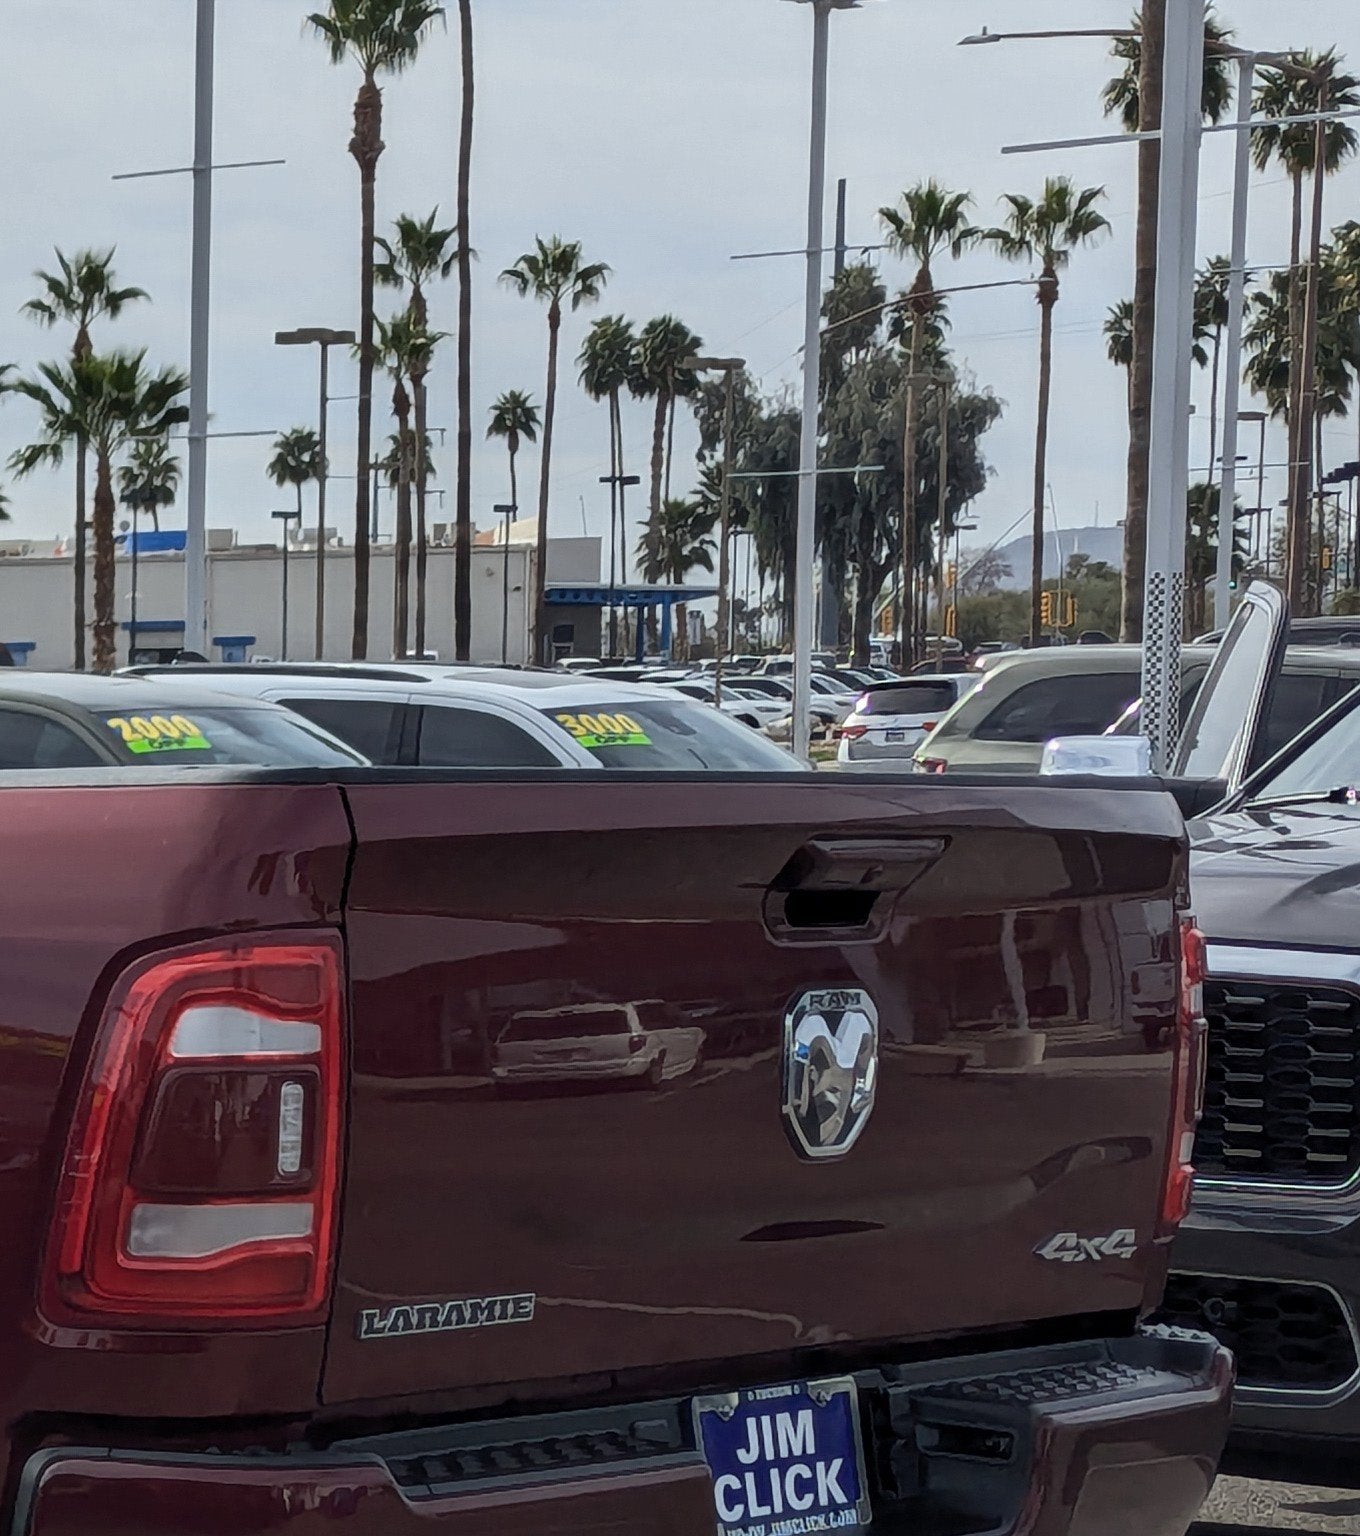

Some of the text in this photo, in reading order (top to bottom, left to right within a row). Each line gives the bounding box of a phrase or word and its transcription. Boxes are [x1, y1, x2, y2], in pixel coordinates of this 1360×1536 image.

[107, 715, 202, 742] 2000
[555, 713, 644, 736] 3000
[358, 1293, 536, 1339] LARAMIE
[735, 1409, 816, 1464] JIM
[713, 1457, 849, 1523] CLICK
